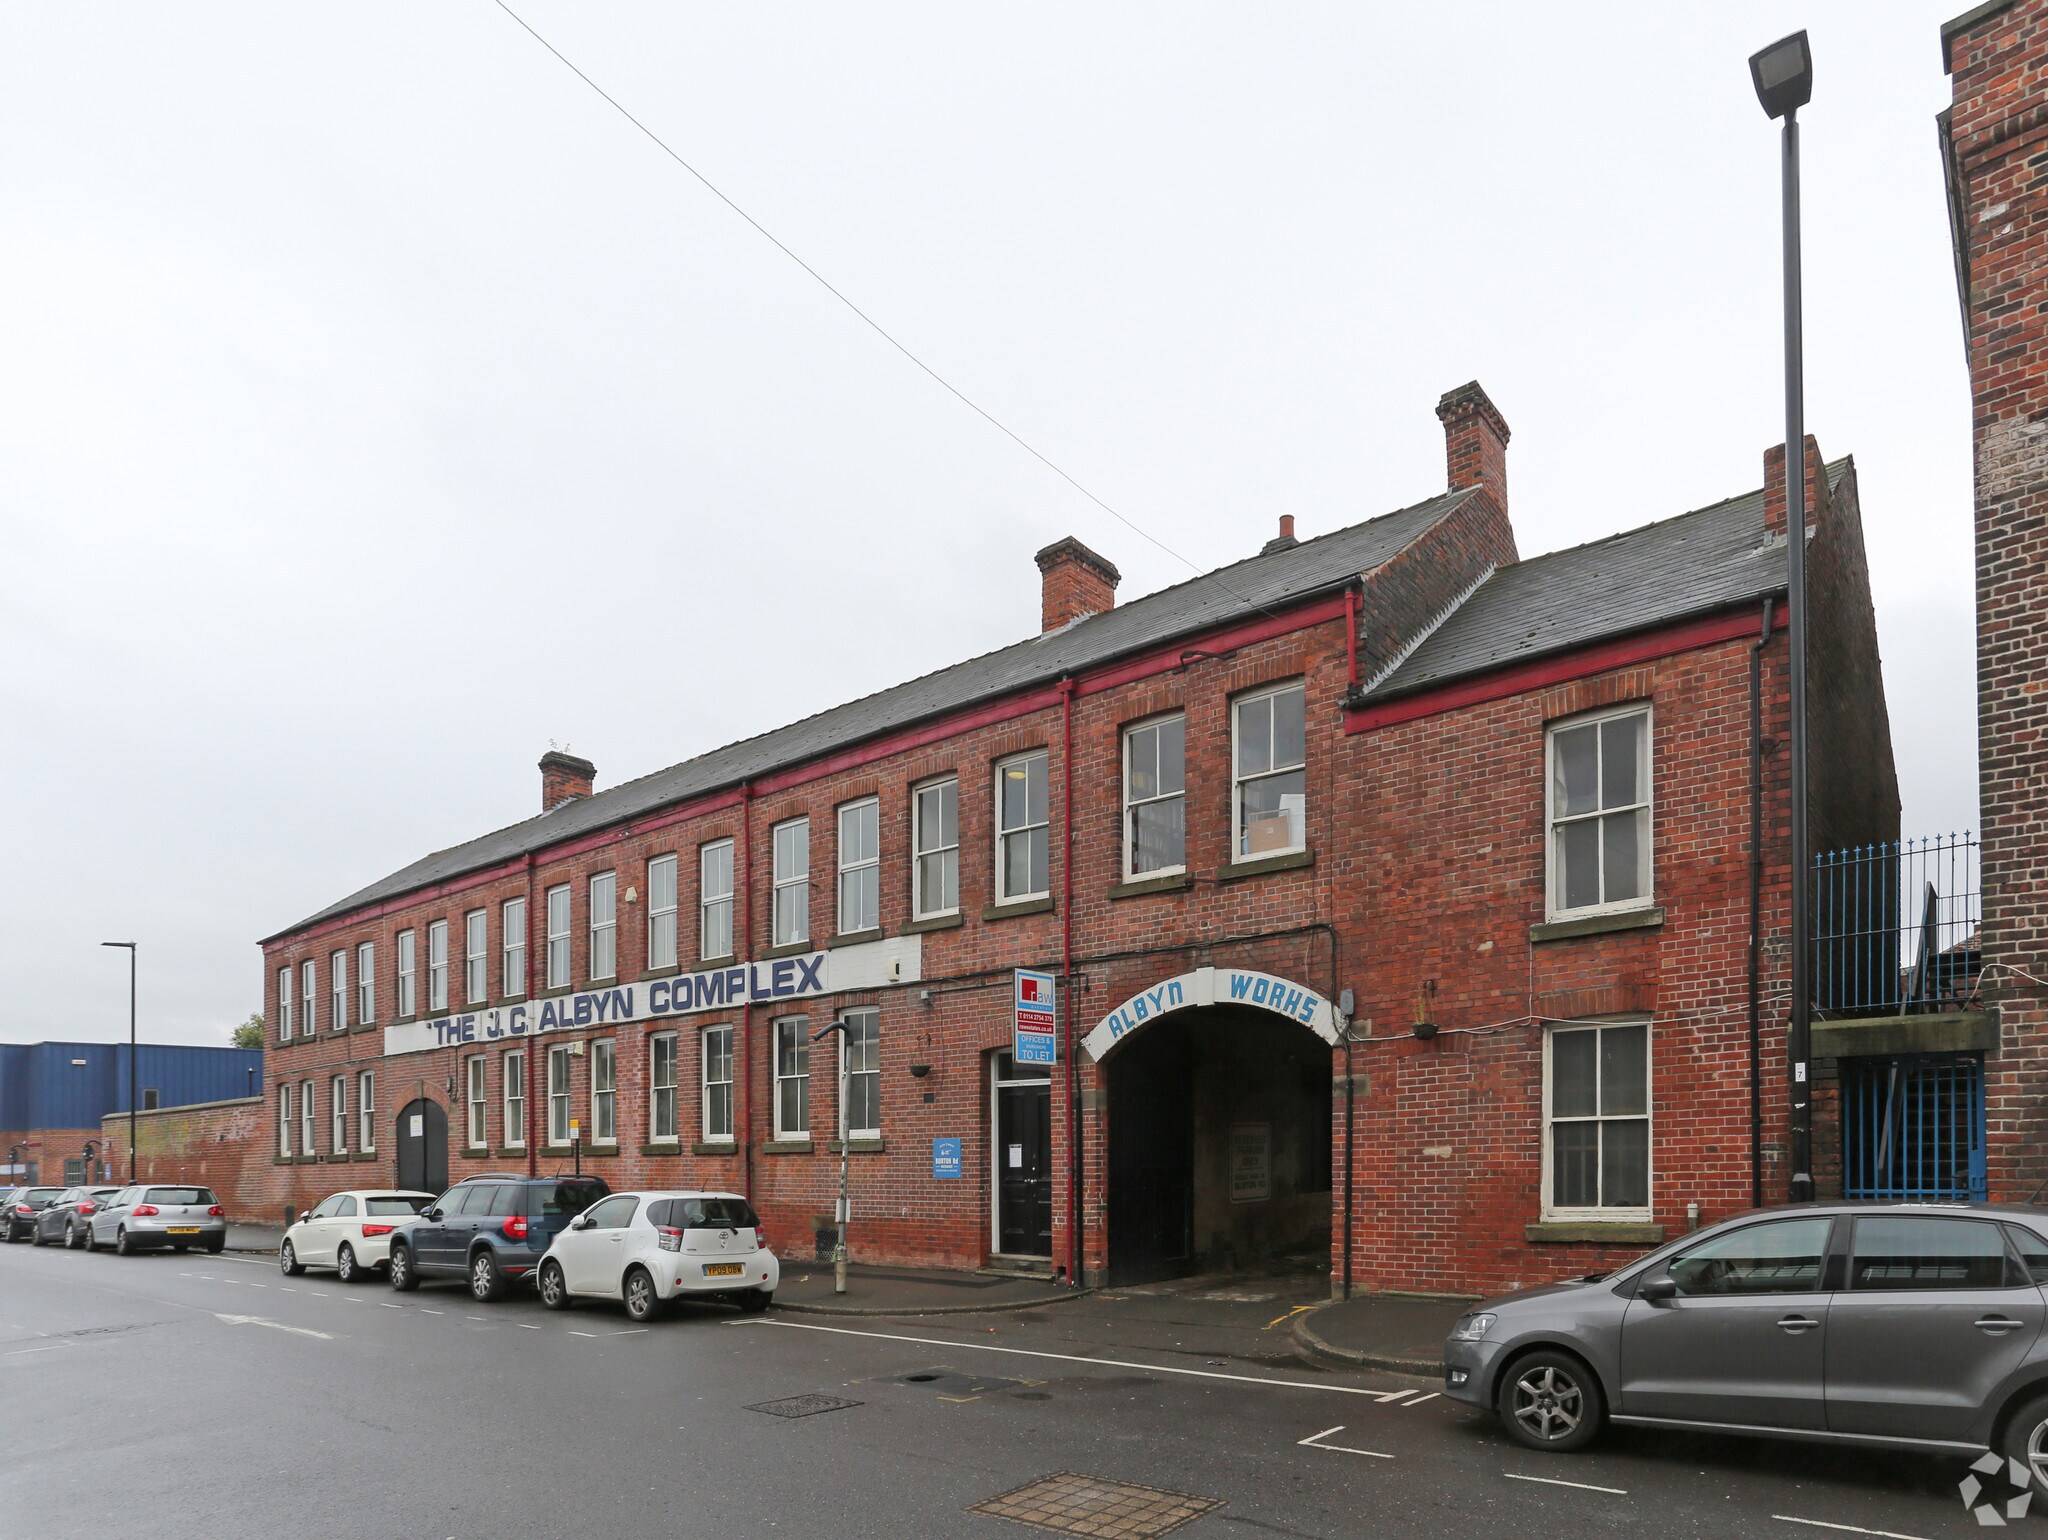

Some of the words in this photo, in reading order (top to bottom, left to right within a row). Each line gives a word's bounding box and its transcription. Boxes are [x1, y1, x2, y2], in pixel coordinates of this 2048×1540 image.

[434, 1015, 474, 1045] THE
[538, 987, 633, 1031] ALBYN
[649, 954, 825, 1014] COMPLEX
[1230, 974, 1319, 1023] WORKS
[1021, 1035, 1045, 1044] OFFICES
[1022, 1050, 1033, 1060] TO
[1035, 1050, 1050, 1061] LET
